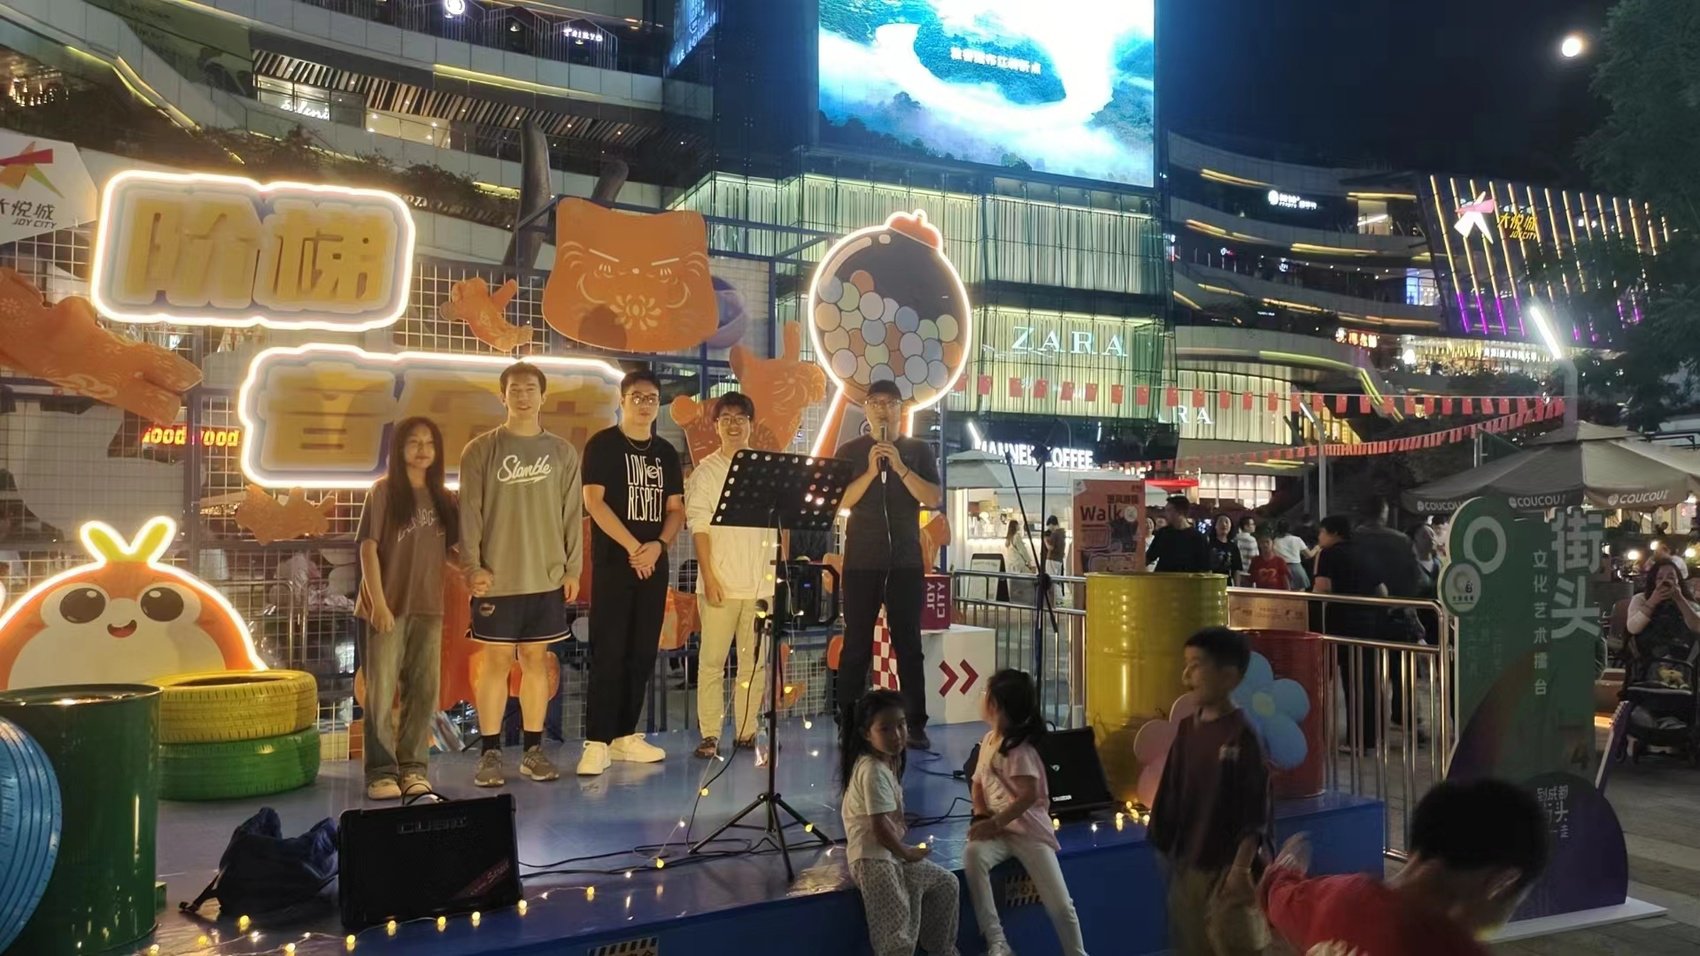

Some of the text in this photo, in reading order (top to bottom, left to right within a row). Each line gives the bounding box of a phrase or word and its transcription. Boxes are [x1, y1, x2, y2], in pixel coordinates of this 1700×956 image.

[122, 196, 387, 304] 阶梯
[1012, 326, 1128, 357] ZARA
[1158, 405, 1215, 425] RA
[192, 429, 240, 447] ood
[625, 453, 648, 486] LOVE
[628, 485, 664, 522] RESPECT
[1517, 494, 1560, 507] COUCOU
[1619, 490, 1664, 504] COUCOU
[1080, 505, 1123, 521] Walk
[1551, 510, 1603, 639] 街头
[927, 582, 936, 610] JOY
[937, 582, 946, 618] CITY
